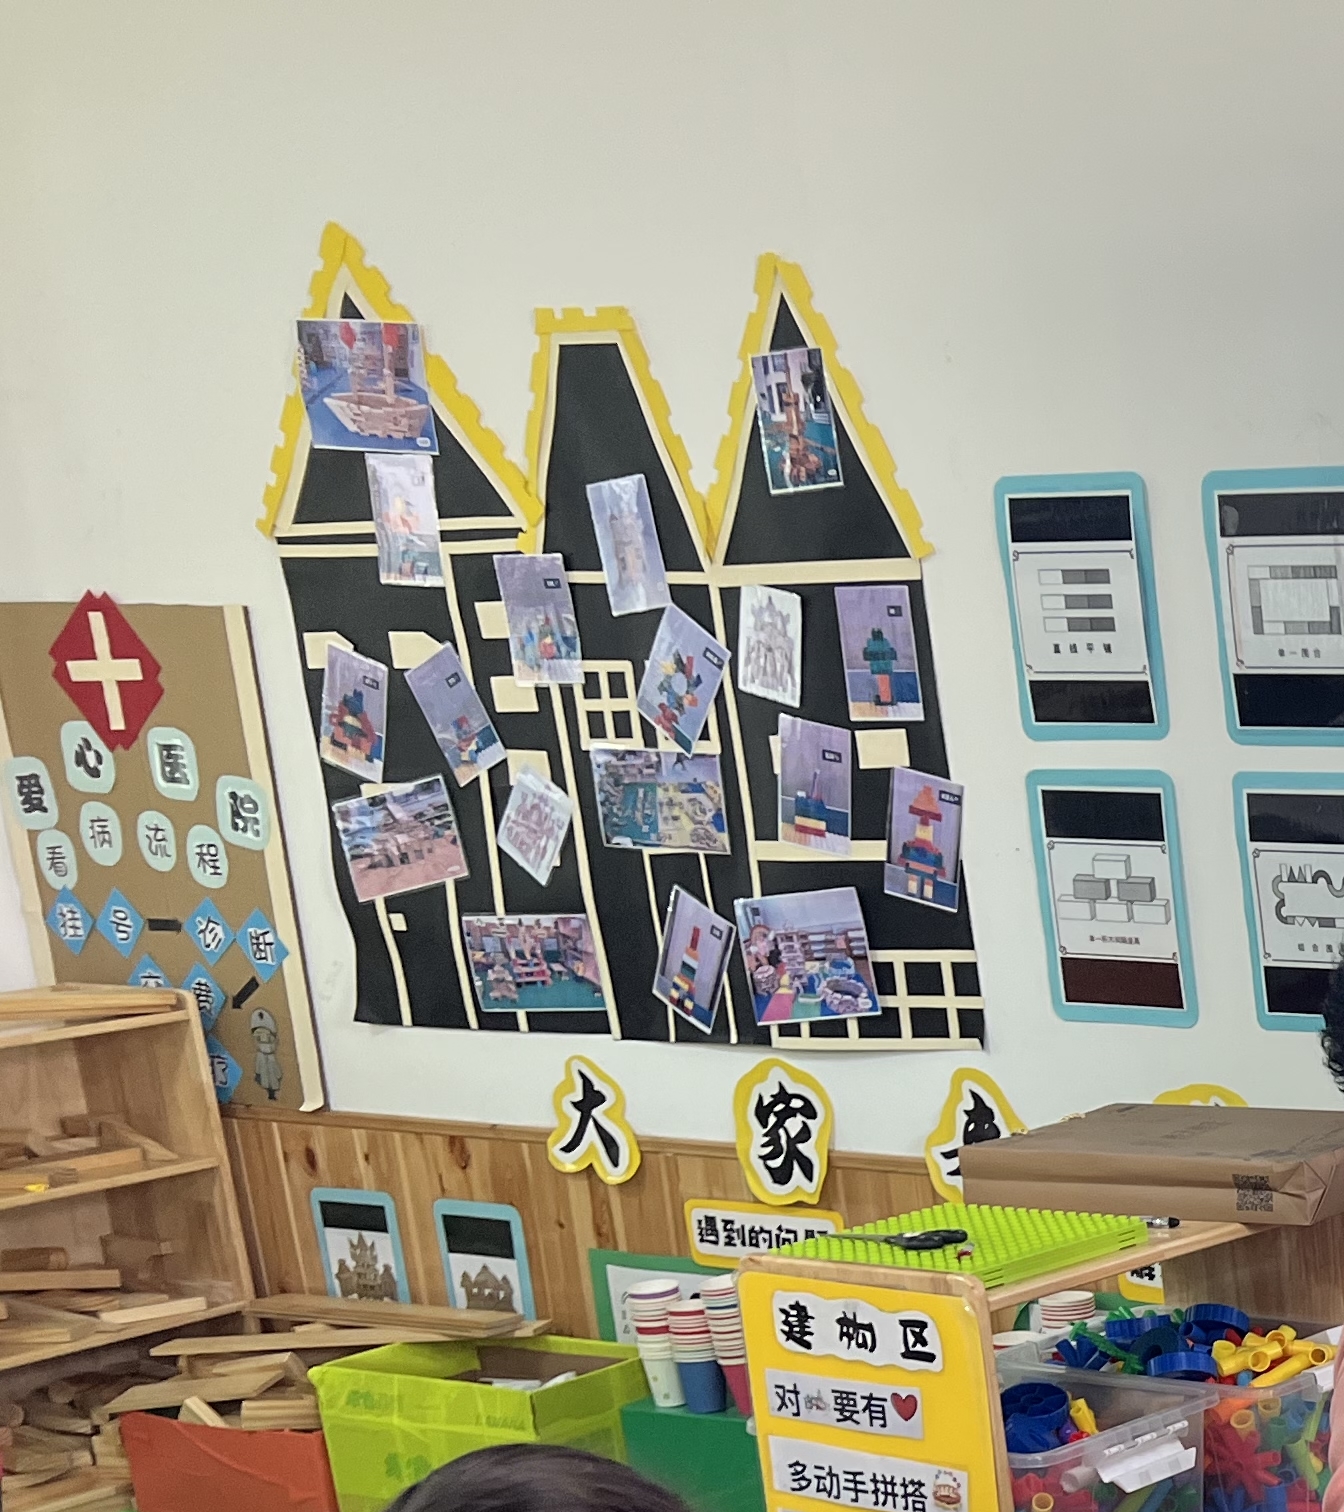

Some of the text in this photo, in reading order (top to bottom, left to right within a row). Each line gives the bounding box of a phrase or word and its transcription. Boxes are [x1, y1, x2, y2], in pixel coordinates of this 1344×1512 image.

[15, 737, 261, 838] 爱心医院
[46, 816, 223, 877] 看病流程
[57, 905, 278, 966] 挂号 诊断
[779, 1301, 937, 1364] 建构区
[774, 1383, 888, 1429] 对 要有
